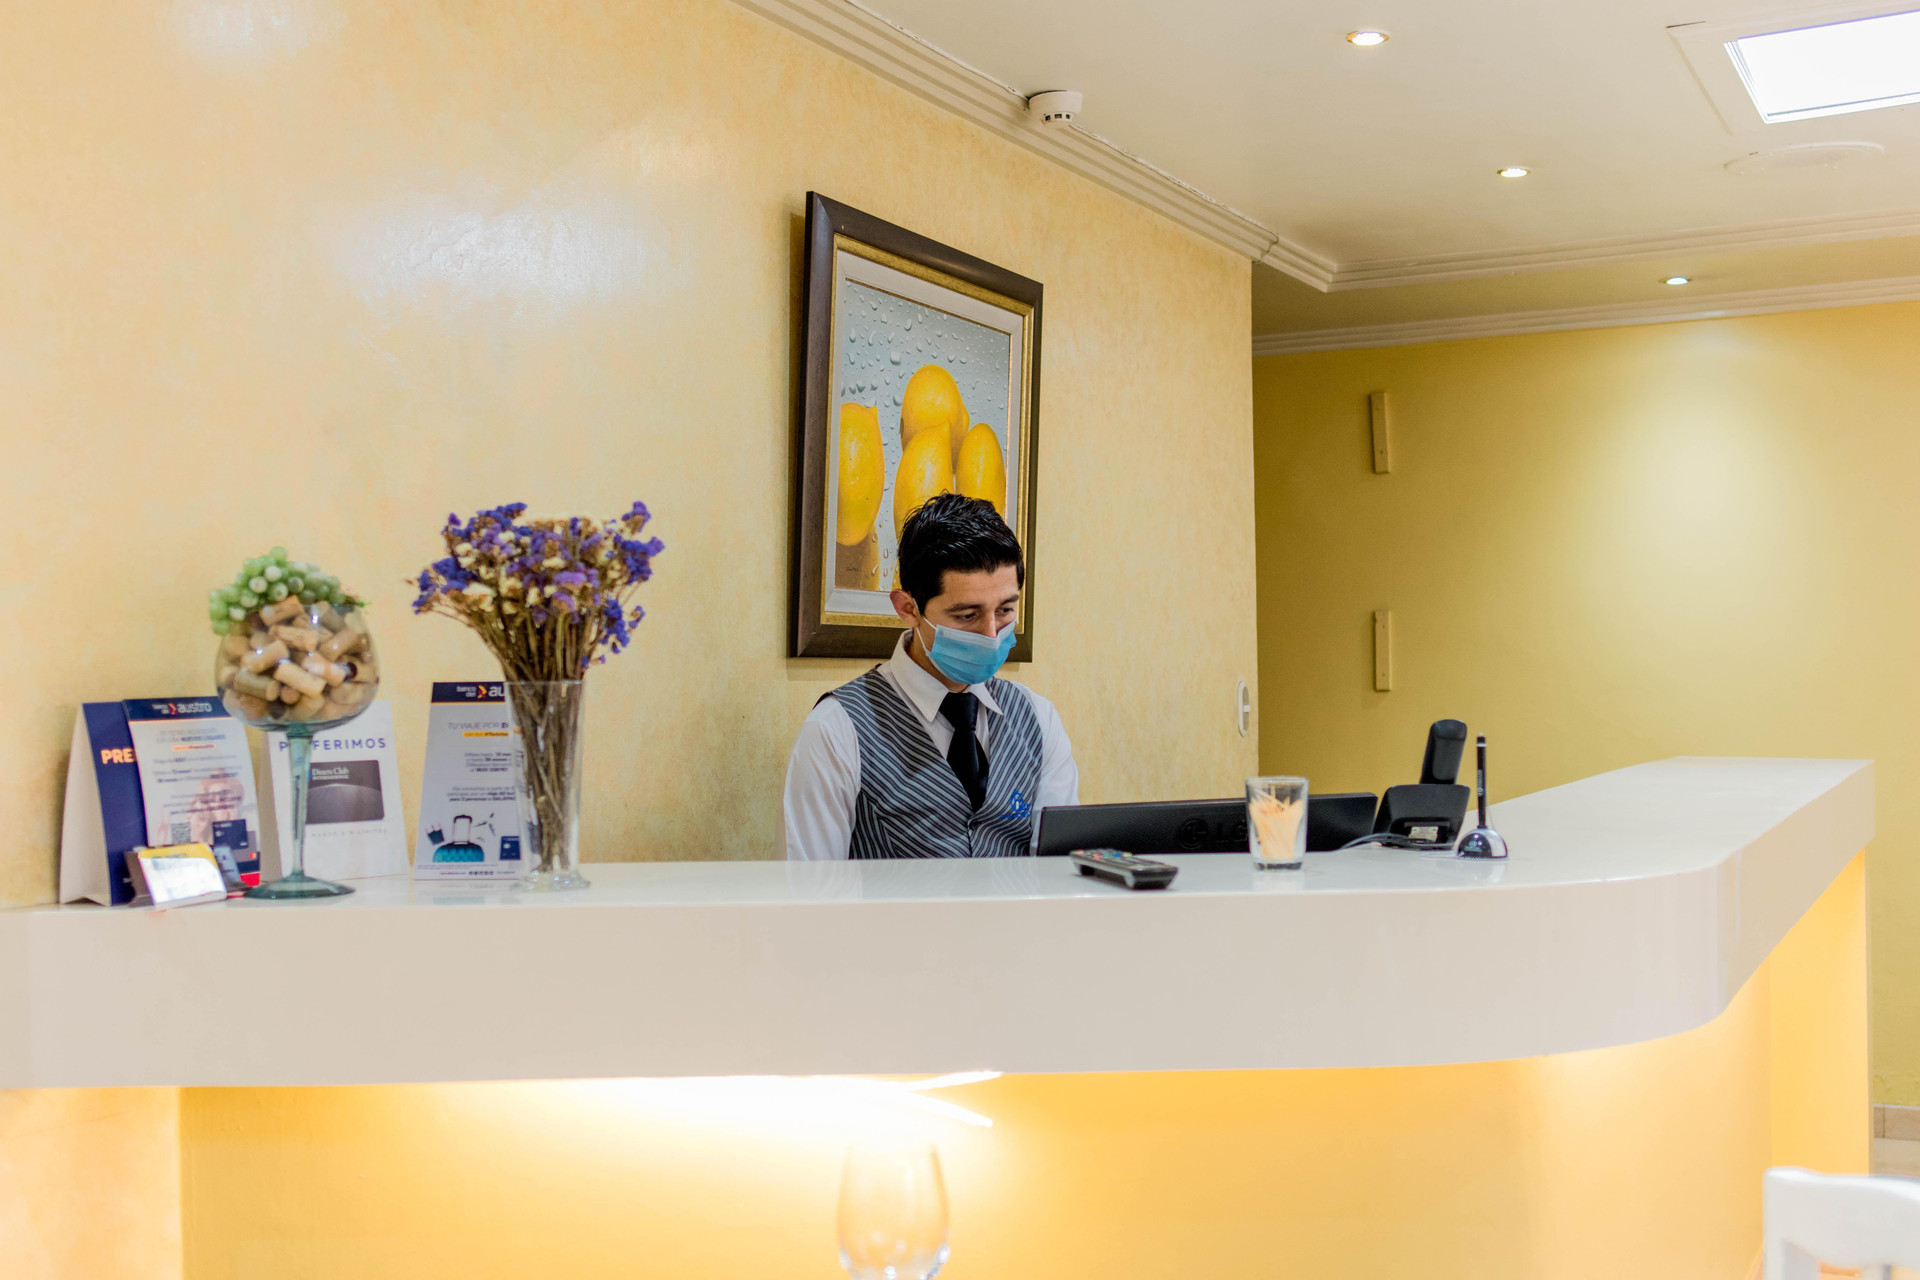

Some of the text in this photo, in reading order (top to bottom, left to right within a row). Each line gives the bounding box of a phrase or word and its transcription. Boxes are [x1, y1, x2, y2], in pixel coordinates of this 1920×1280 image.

[177, 702, 213, 713] austro
[279, 738, 387, 752] PFERIMOS
[100, 748, 137, 765] PRE
[333, 766, 350, 775] Club
